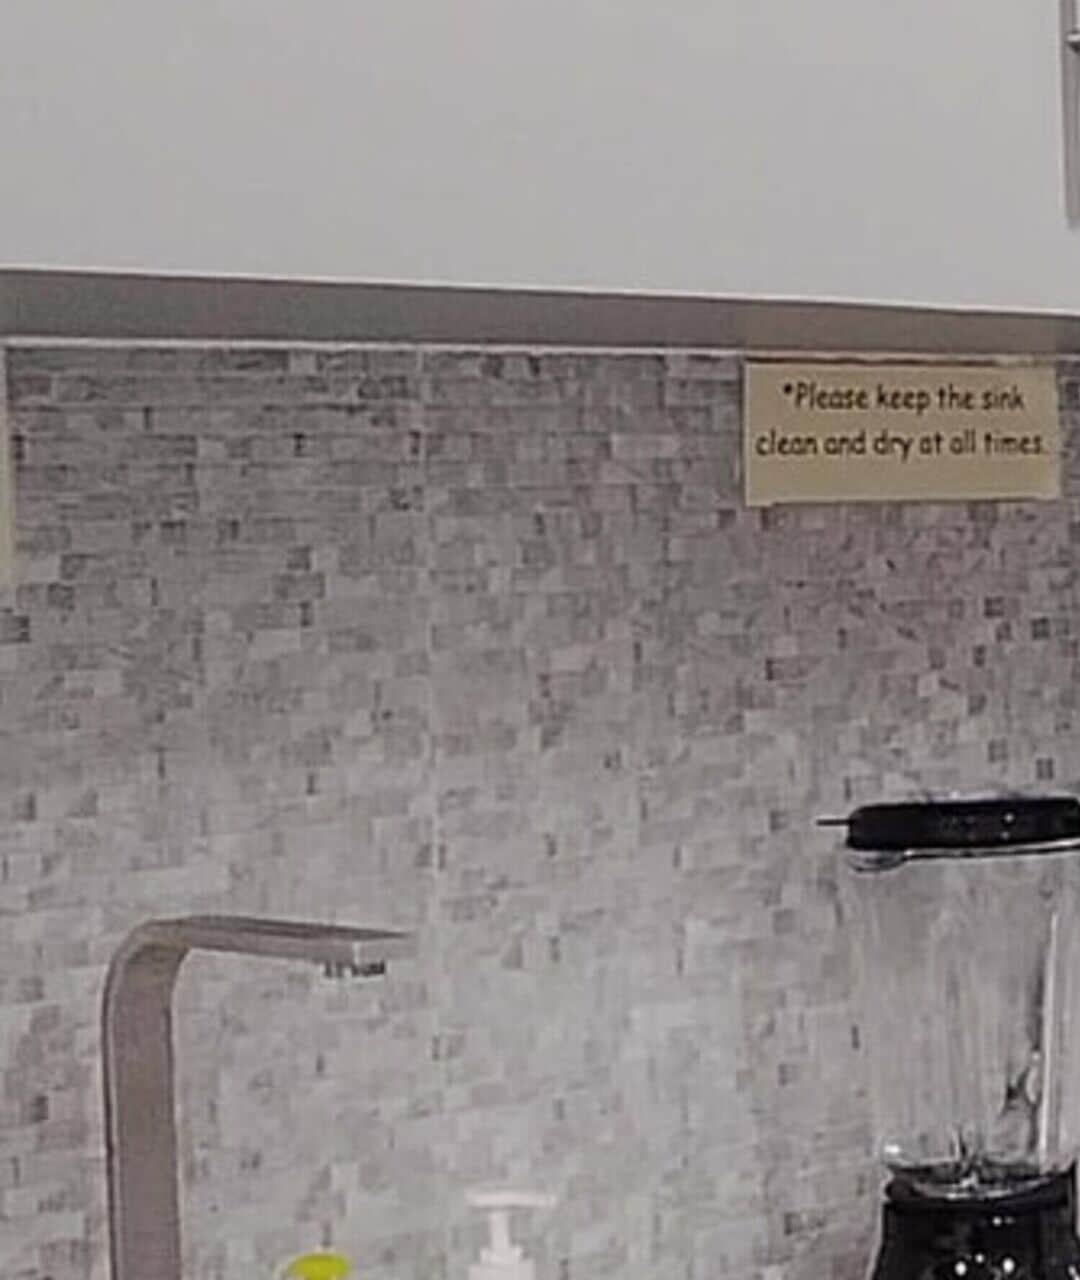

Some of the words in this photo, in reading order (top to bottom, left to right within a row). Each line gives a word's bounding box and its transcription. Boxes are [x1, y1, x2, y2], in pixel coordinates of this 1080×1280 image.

[877, 382, 930, 416] keep
[937, 382, 974, 410] the
[981, 383, 1024, 410] sink
[755, 428, 818, 456] clean
[823, 429, 867, 456] and
[873, 428, 913, 461] dry
[919, 431, 945, 456] at
[949, 428, 976, 456] all
